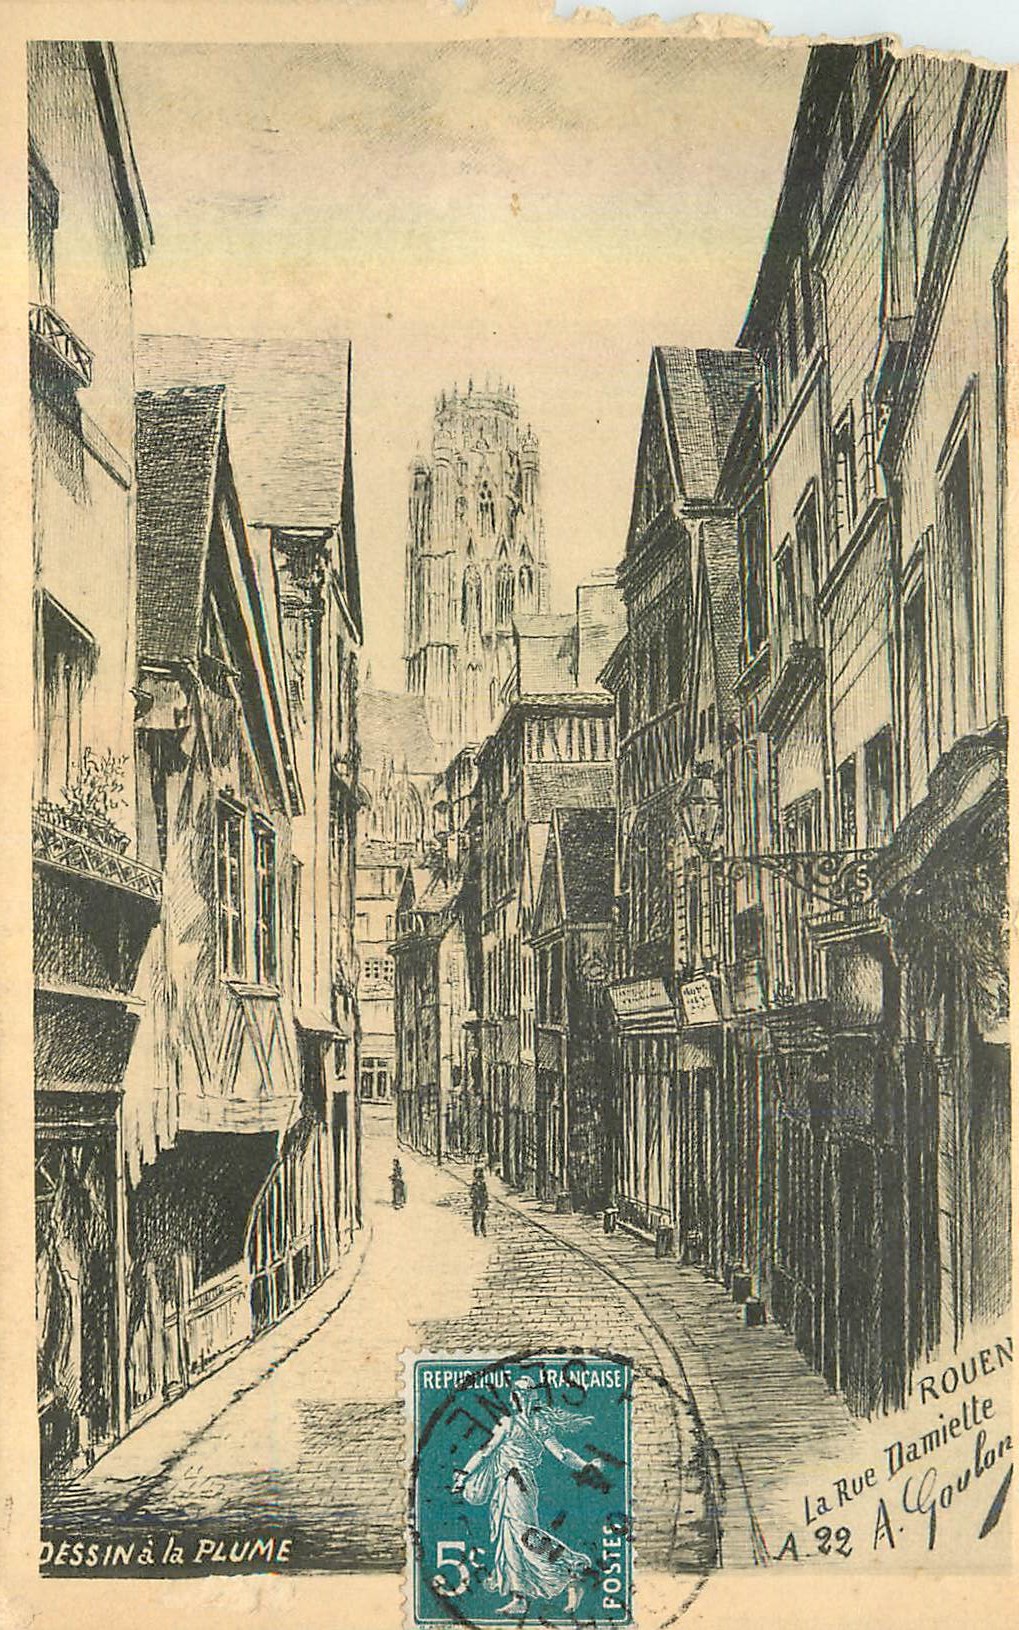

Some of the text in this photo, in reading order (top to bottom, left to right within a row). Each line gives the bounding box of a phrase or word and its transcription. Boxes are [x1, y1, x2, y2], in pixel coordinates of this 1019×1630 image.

[540, 1370, 622, 1391] FRANÇAISE
[918, 1337, 1014, 1405] ROUEN
[805, 1395, 995, 1527] La Rue Damiette
[40, 1536, 292, 1566] DESSIN à la PLUME
[814, 1526, 853, 1558] 22
